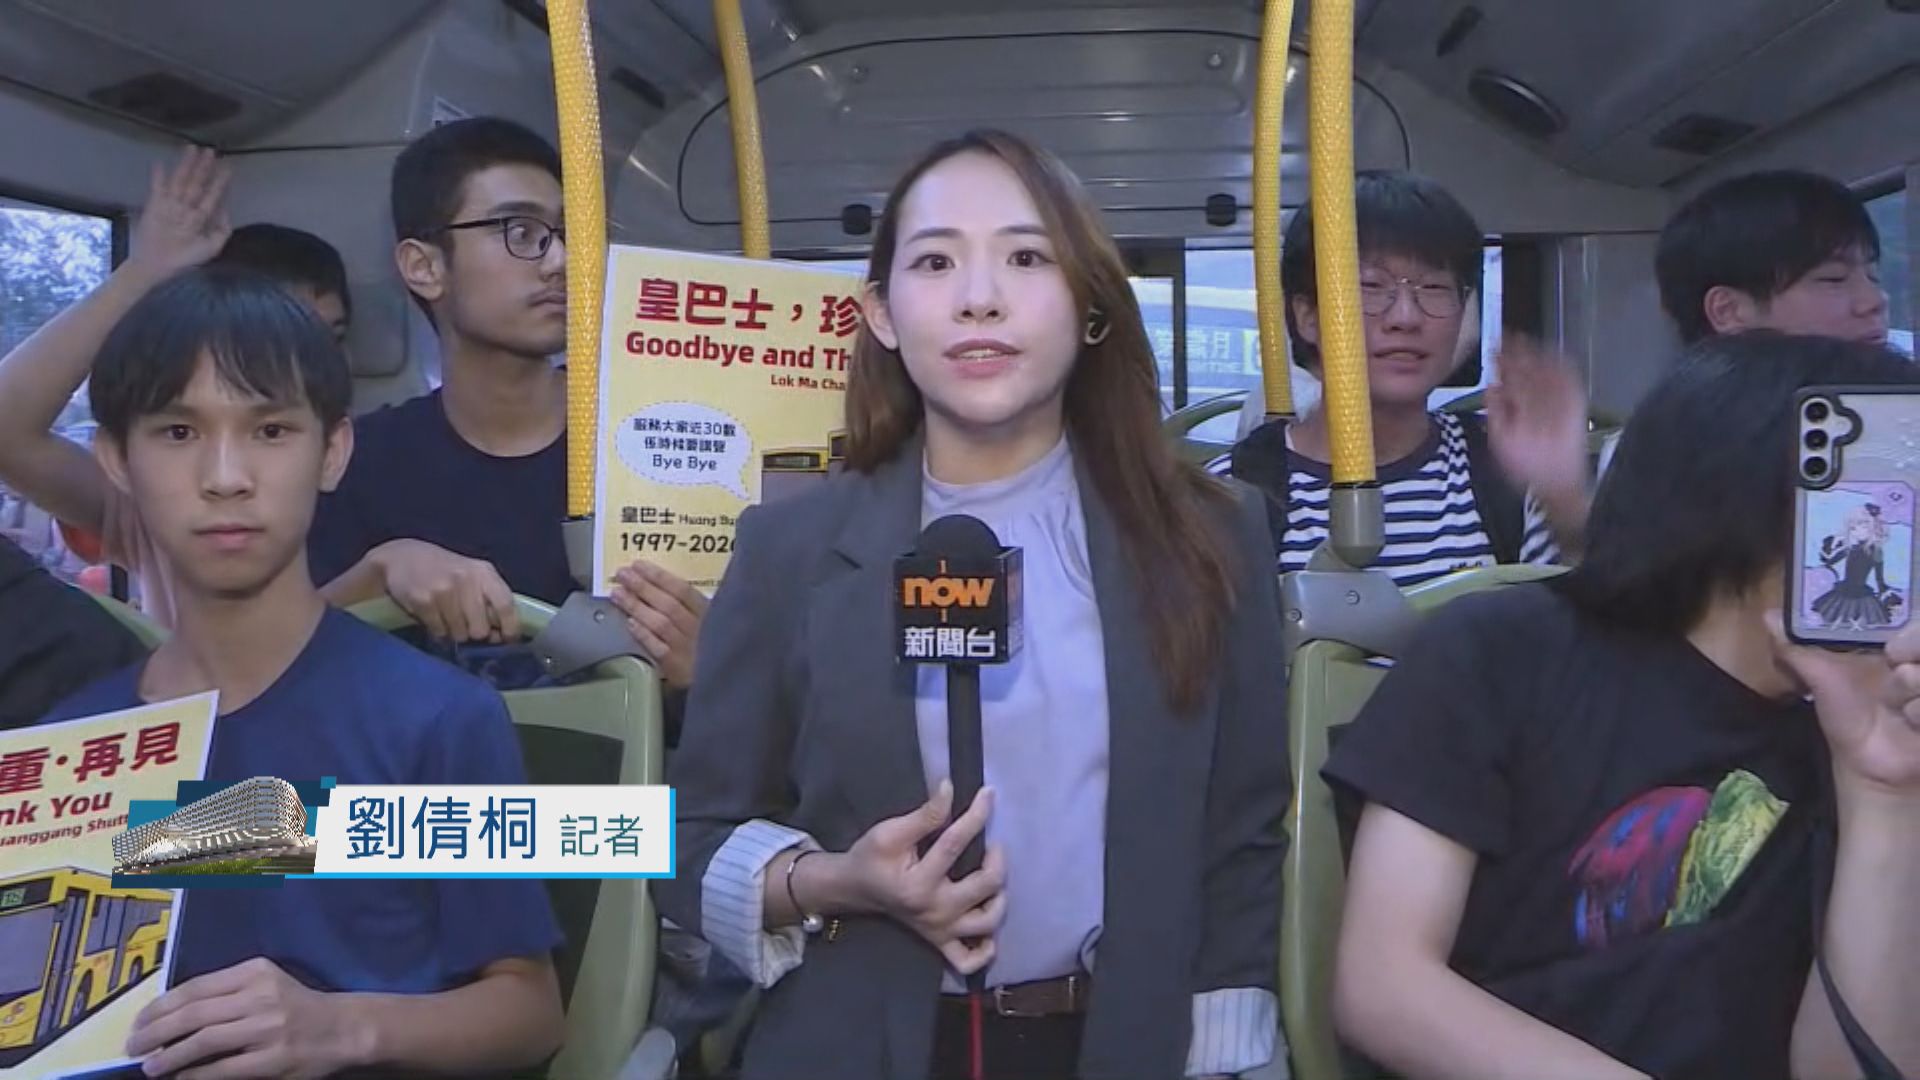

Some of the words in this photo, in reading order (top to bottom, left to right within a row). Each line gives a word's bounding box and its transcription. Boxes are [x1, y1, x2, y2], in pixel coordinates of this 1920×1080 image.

[635, 278, 863, 338] 皇巴士，珍
[626, 331, 755, 368] Goodbye
[762, 345, 815, 370] and
[771, 374, 795, 388] Lok
[799, 376, 819, 390] Ma
[652, 454, 683, 470] Bye
[687, 456, 718, 473] Bye
[621, 506, 677, 525] 皇巴士
[679, 514, 717, 528] Huang
[903, 577, 995, 608] now
[904, 626, 996, 658] 新聞台
[51, 792, 113, 820] You
